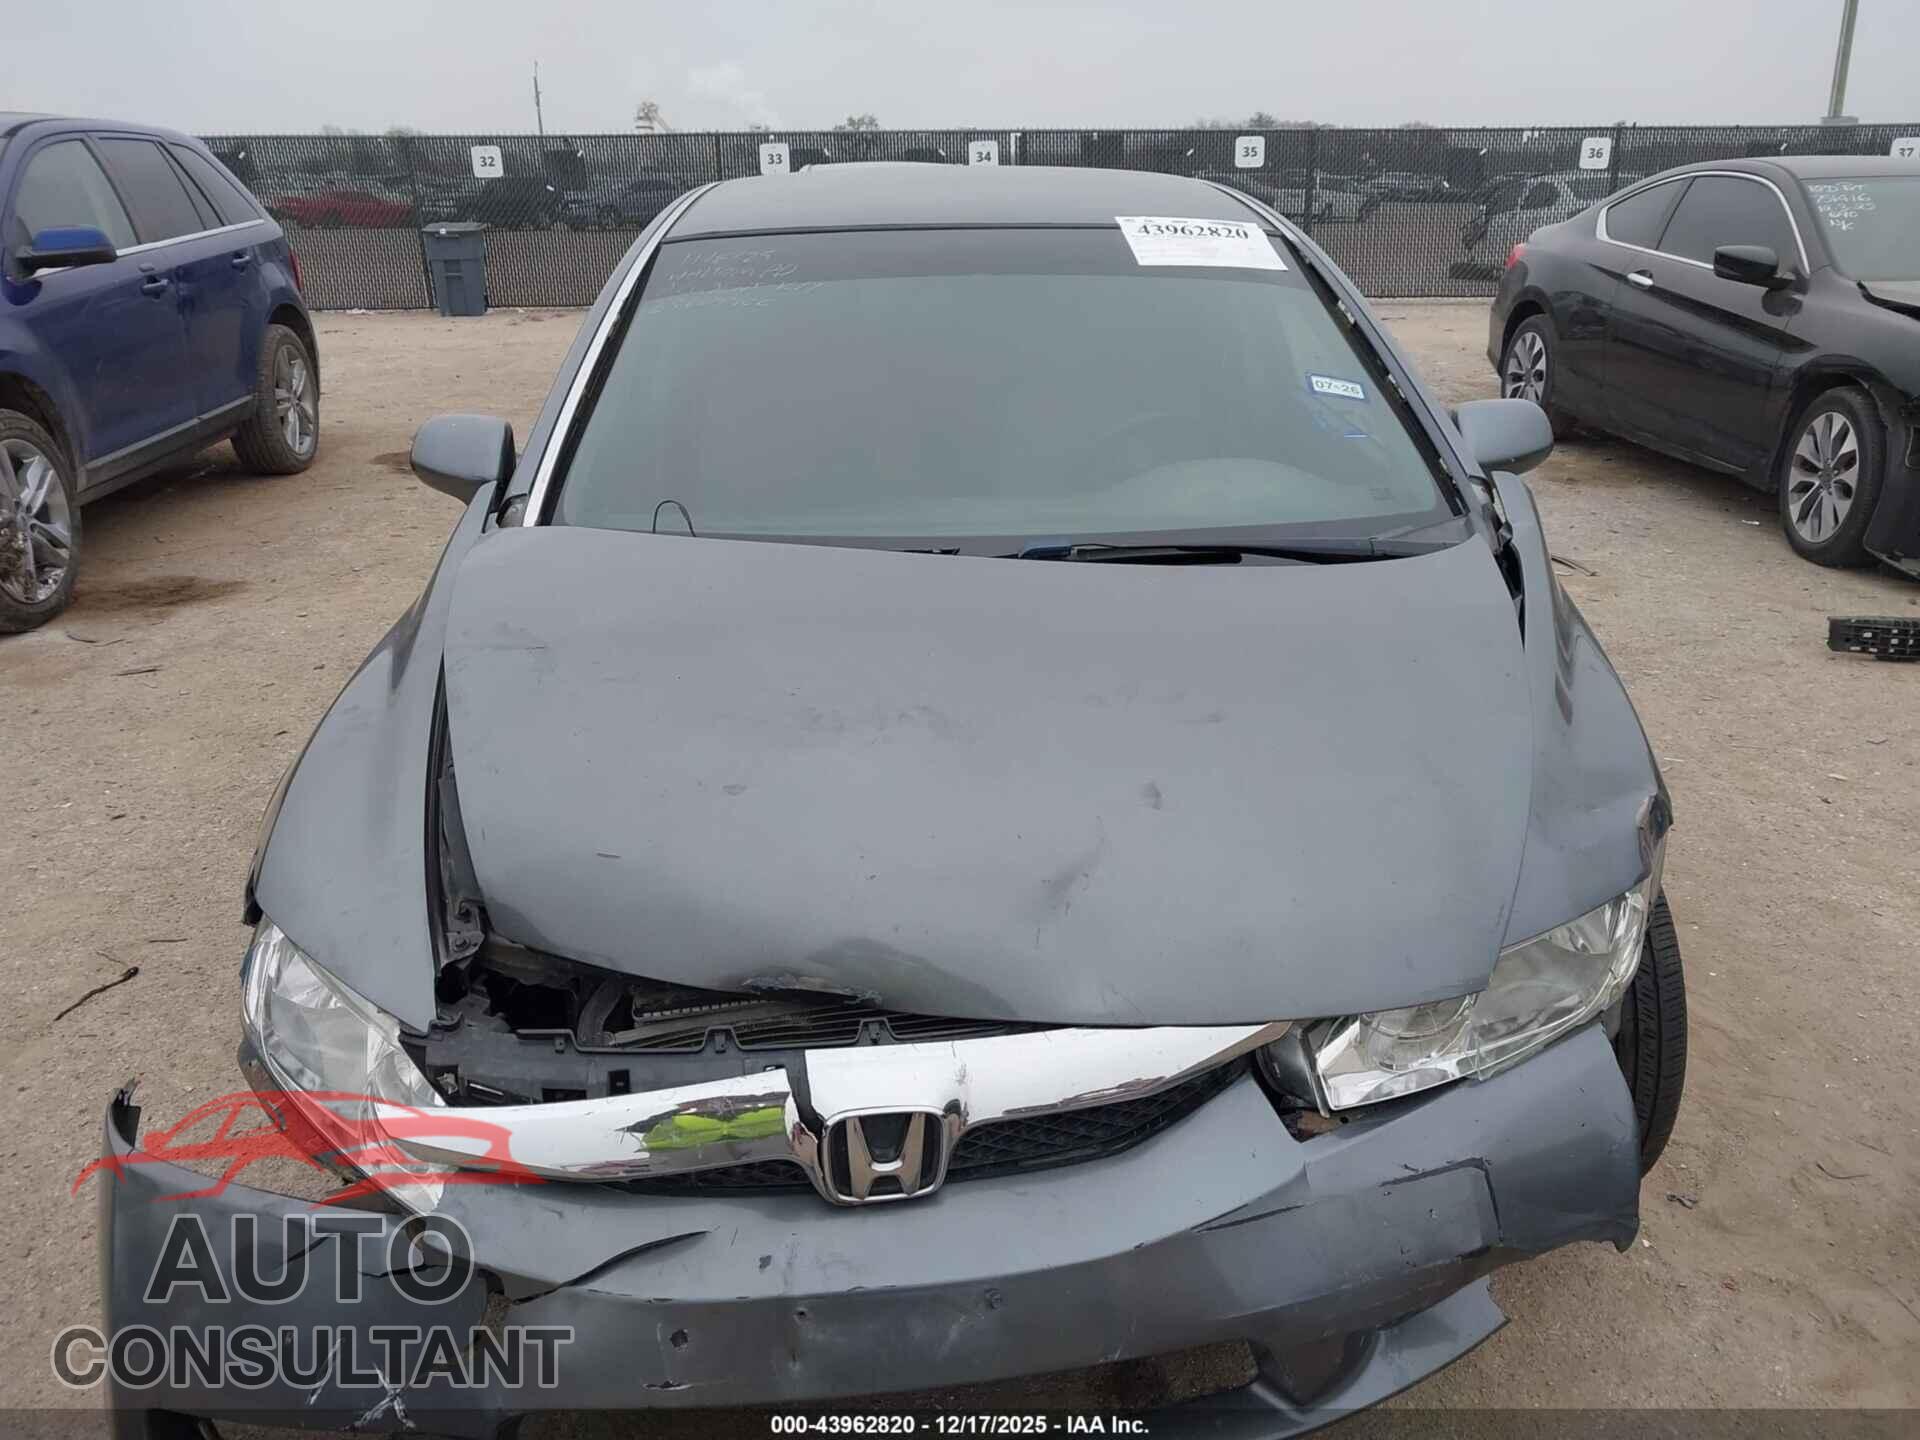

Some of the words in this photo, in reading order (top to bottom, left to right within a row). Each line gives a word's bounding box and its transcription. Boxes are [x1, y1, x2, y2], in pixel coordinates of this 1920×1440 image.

[975, 151, 991, 162] 34
[1241, 146, 1258, 157] 35
[1587, 147, 1604, 159] 36
[479, 155, 496, 167] 32
[767, 153, 783, 165] 33
[1138, 224, 1249, 239] 43962820
